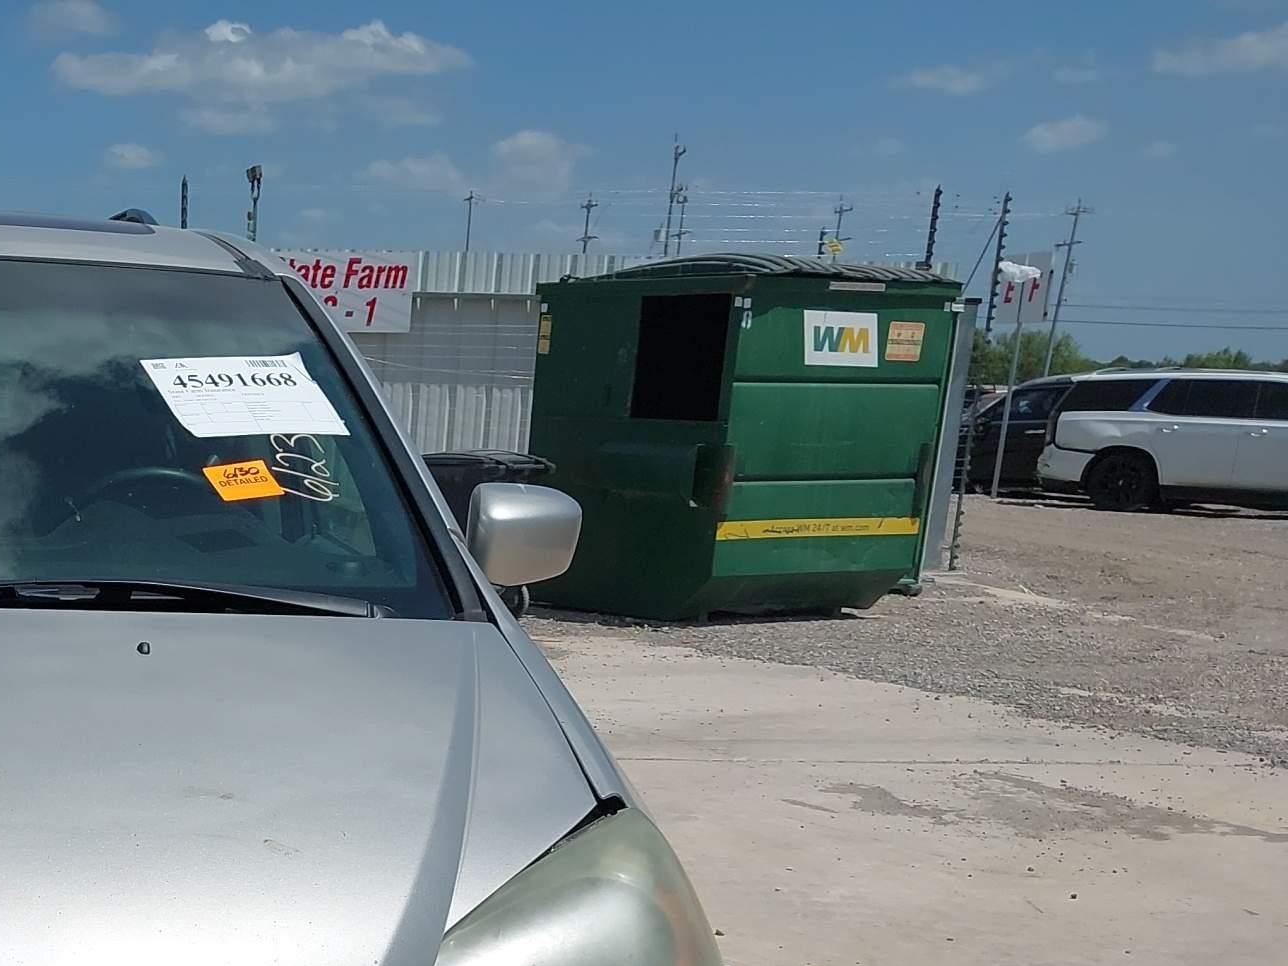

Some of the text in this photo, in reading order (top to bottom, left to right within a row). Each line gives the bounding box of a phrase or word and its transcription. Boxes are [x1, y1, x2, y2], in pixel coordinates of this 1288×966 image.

[343, 257, 409, 289] Farm
[814, 325, 870, 353] WM
[172, 372, 297, 388] 45491668
[218, 475, 269, 488] DETAILED
